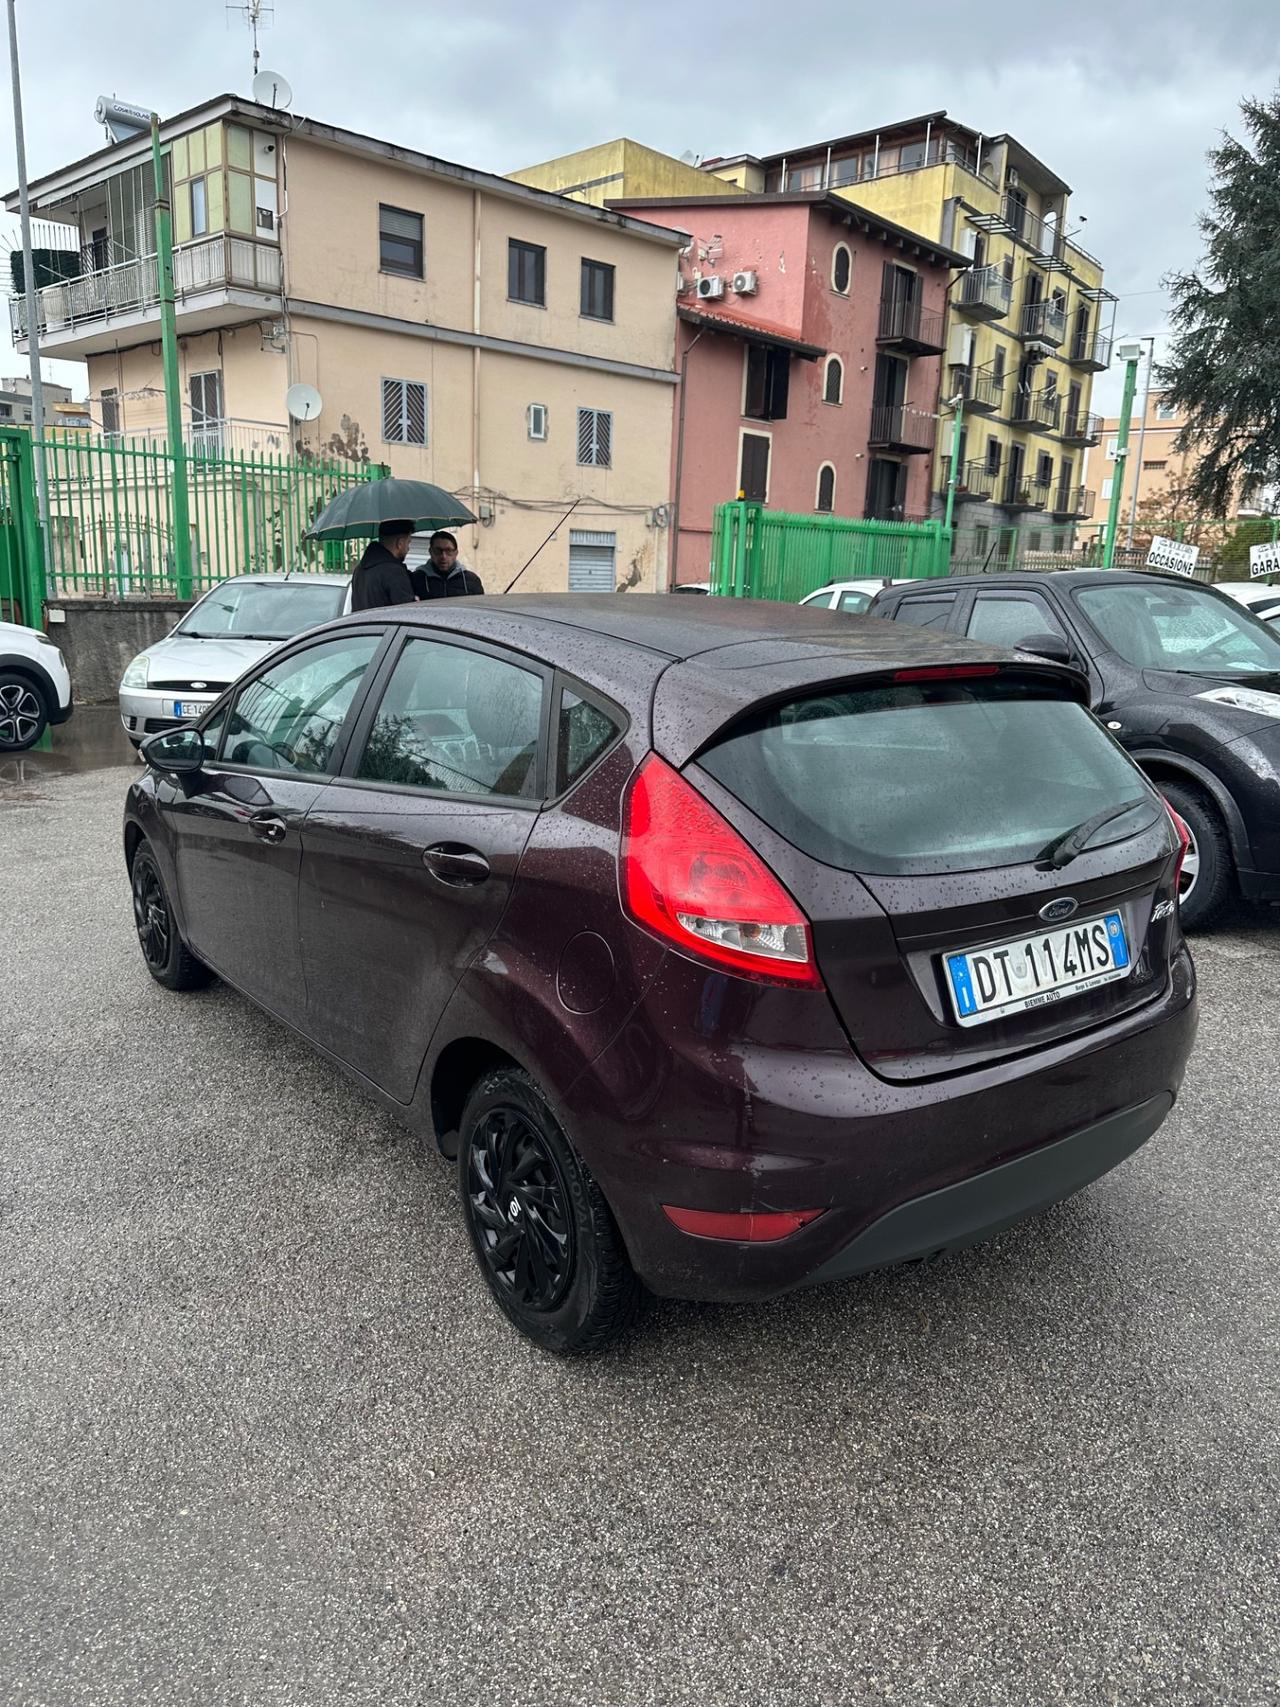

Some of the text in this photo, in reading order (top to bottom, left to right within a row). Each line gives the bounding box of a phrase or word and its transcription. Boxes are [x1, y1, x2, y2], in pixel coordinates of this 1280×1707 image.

[1149, 552, 1193, 575] OCCASIONE
[1252, 558, 1280, 575] GARA
[972, 924, 1111, 1004] DT 114MS
[1046, 991, 1061, 1003] AUTO
